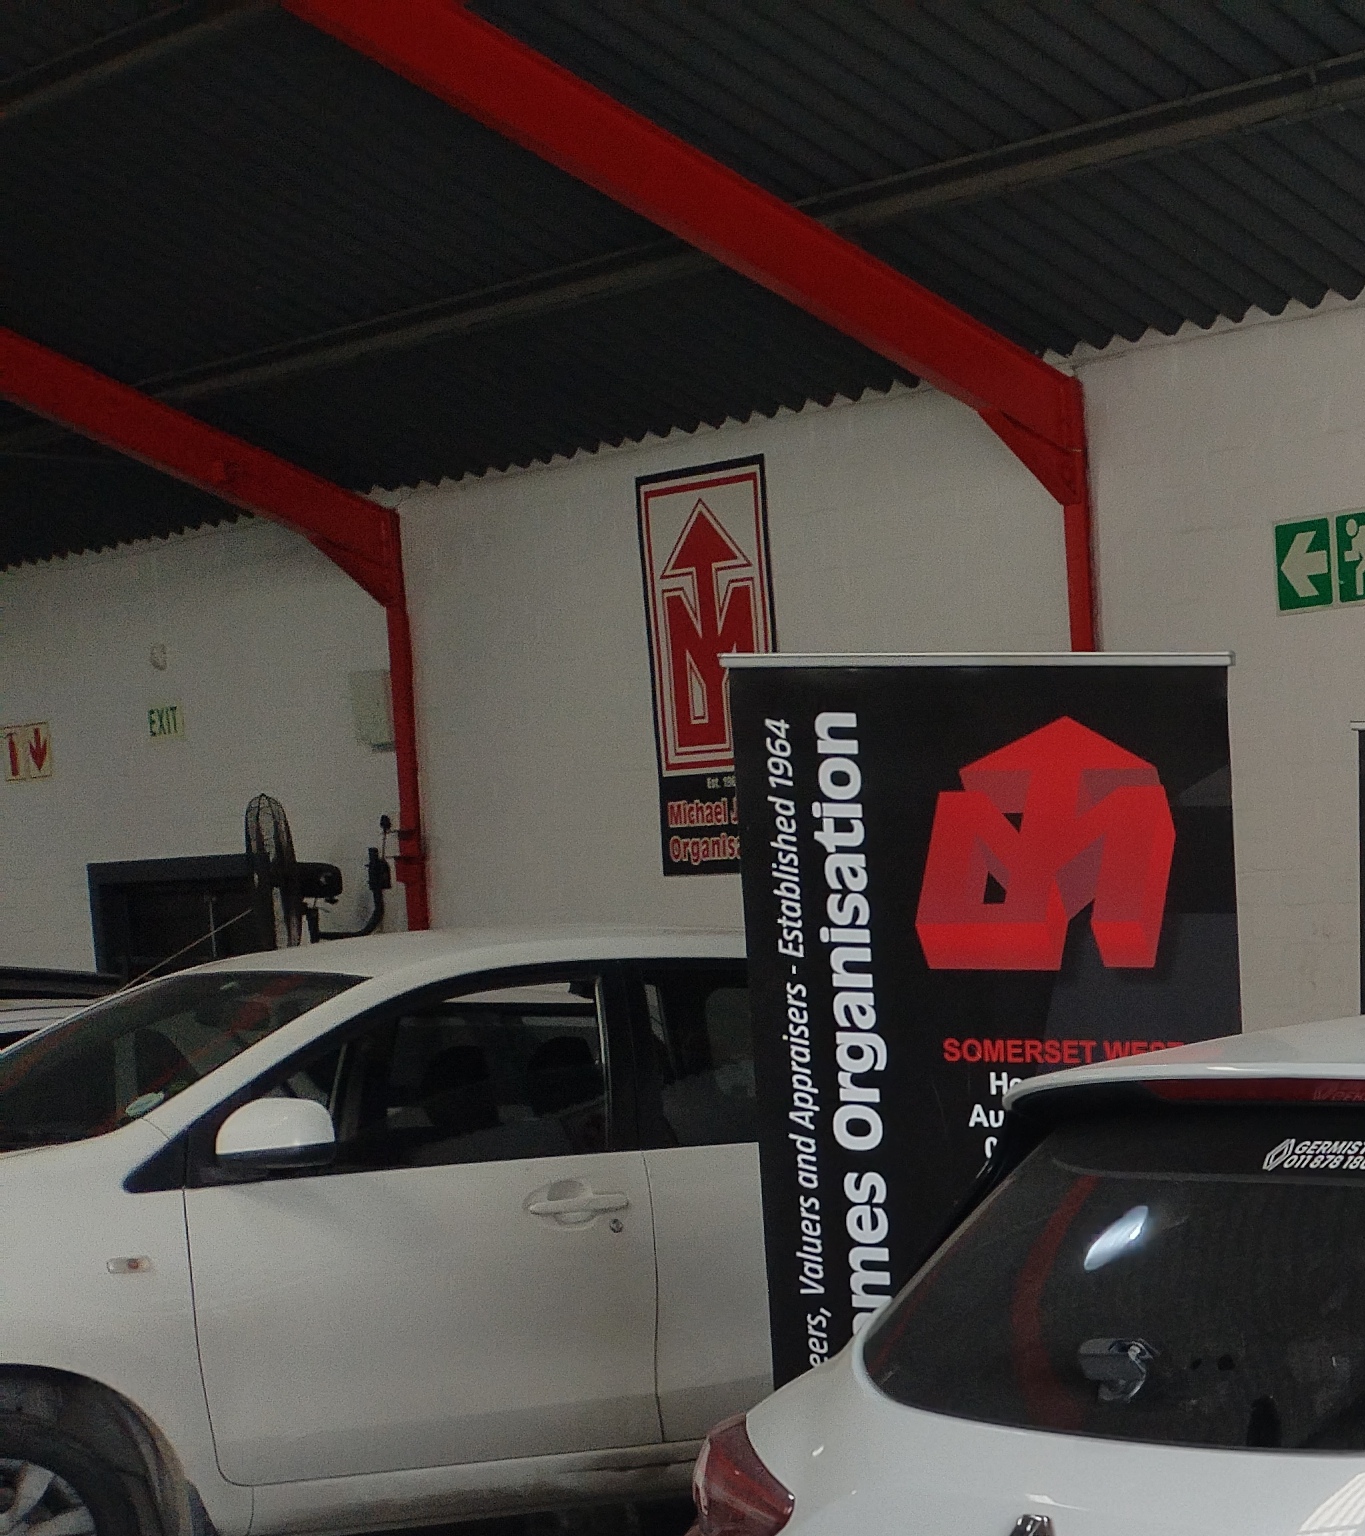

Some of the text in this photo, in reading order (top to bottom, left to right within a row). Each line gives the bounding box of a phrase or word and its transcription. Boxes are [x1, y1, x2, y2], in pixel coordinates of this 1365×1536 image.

[148, 705, 178, 737] EXIT
[764, 717, 794, 788] 1964
[667, 797, 729, 828] Michael
[669, 832, 741, 866] Organis
[767, 795, 805, 958] Established
[811, 711, 888, 1152] Organisation
[782, 981, 821, 1130] Appraisers
[942, 1037, 1098, 1065] SOMERSET
[788, 1132, 818, 1190] and
[795, 1194, 826, 1296] Valuers
